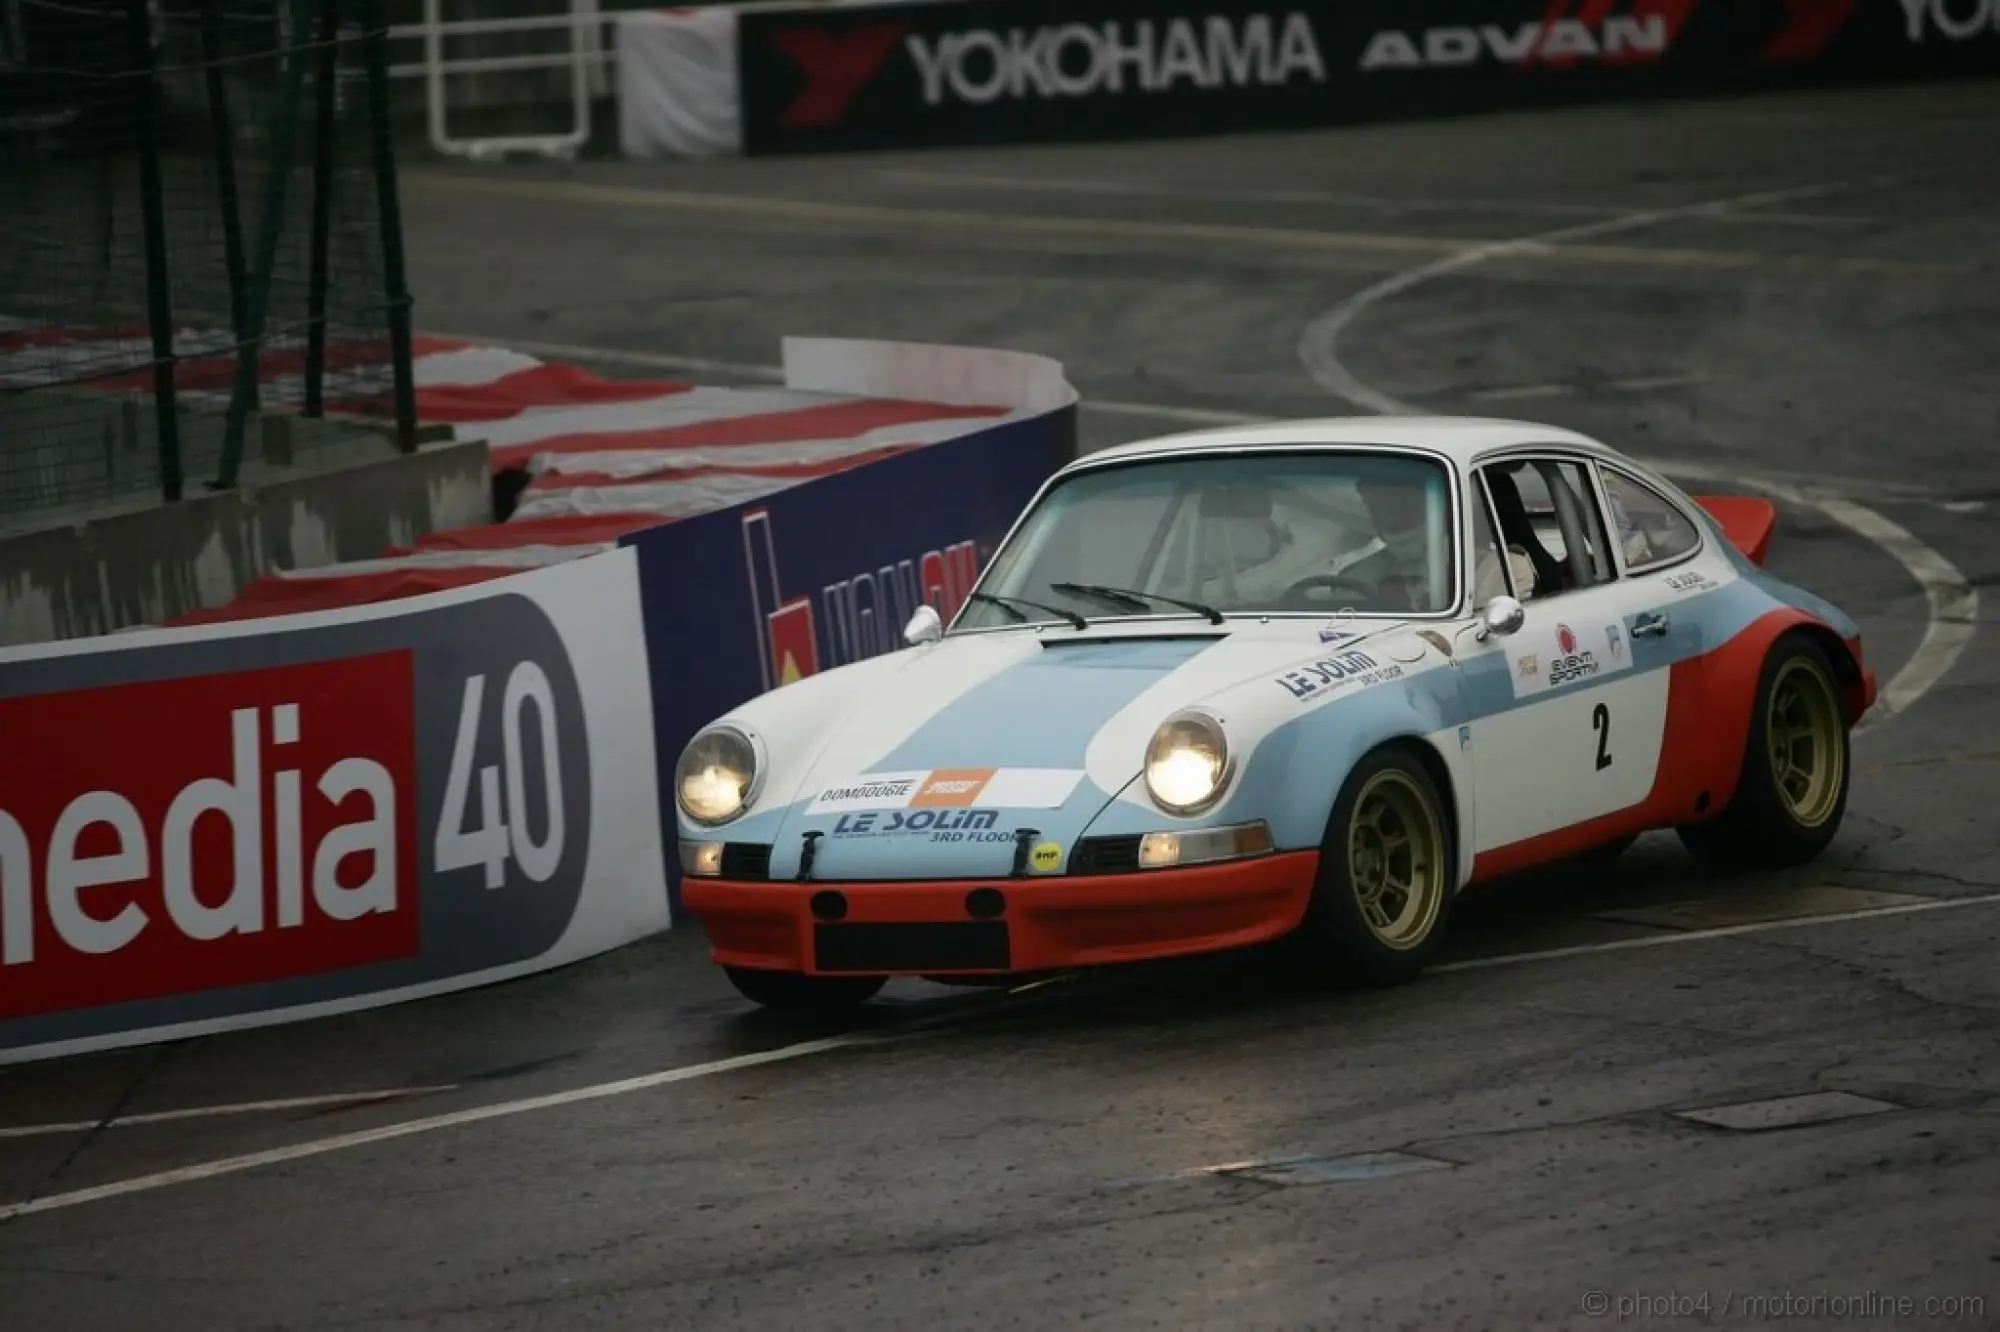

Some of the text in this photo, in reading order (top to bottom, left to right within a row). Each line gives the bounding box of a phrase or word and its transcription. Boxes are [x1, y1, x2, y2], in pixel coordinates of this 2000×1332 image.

[905, 12, 1326, 103] YOKOHAMA
[1358, 15, 1667, 70] ADVAN
[1899, 0, 2000, 42] YO
[1592, 702, 1613, 772] 2
[432, 660, 566, 890] 40
[833, 812, 878, 834] LE
[928, 831, 965, 843] 3RD
